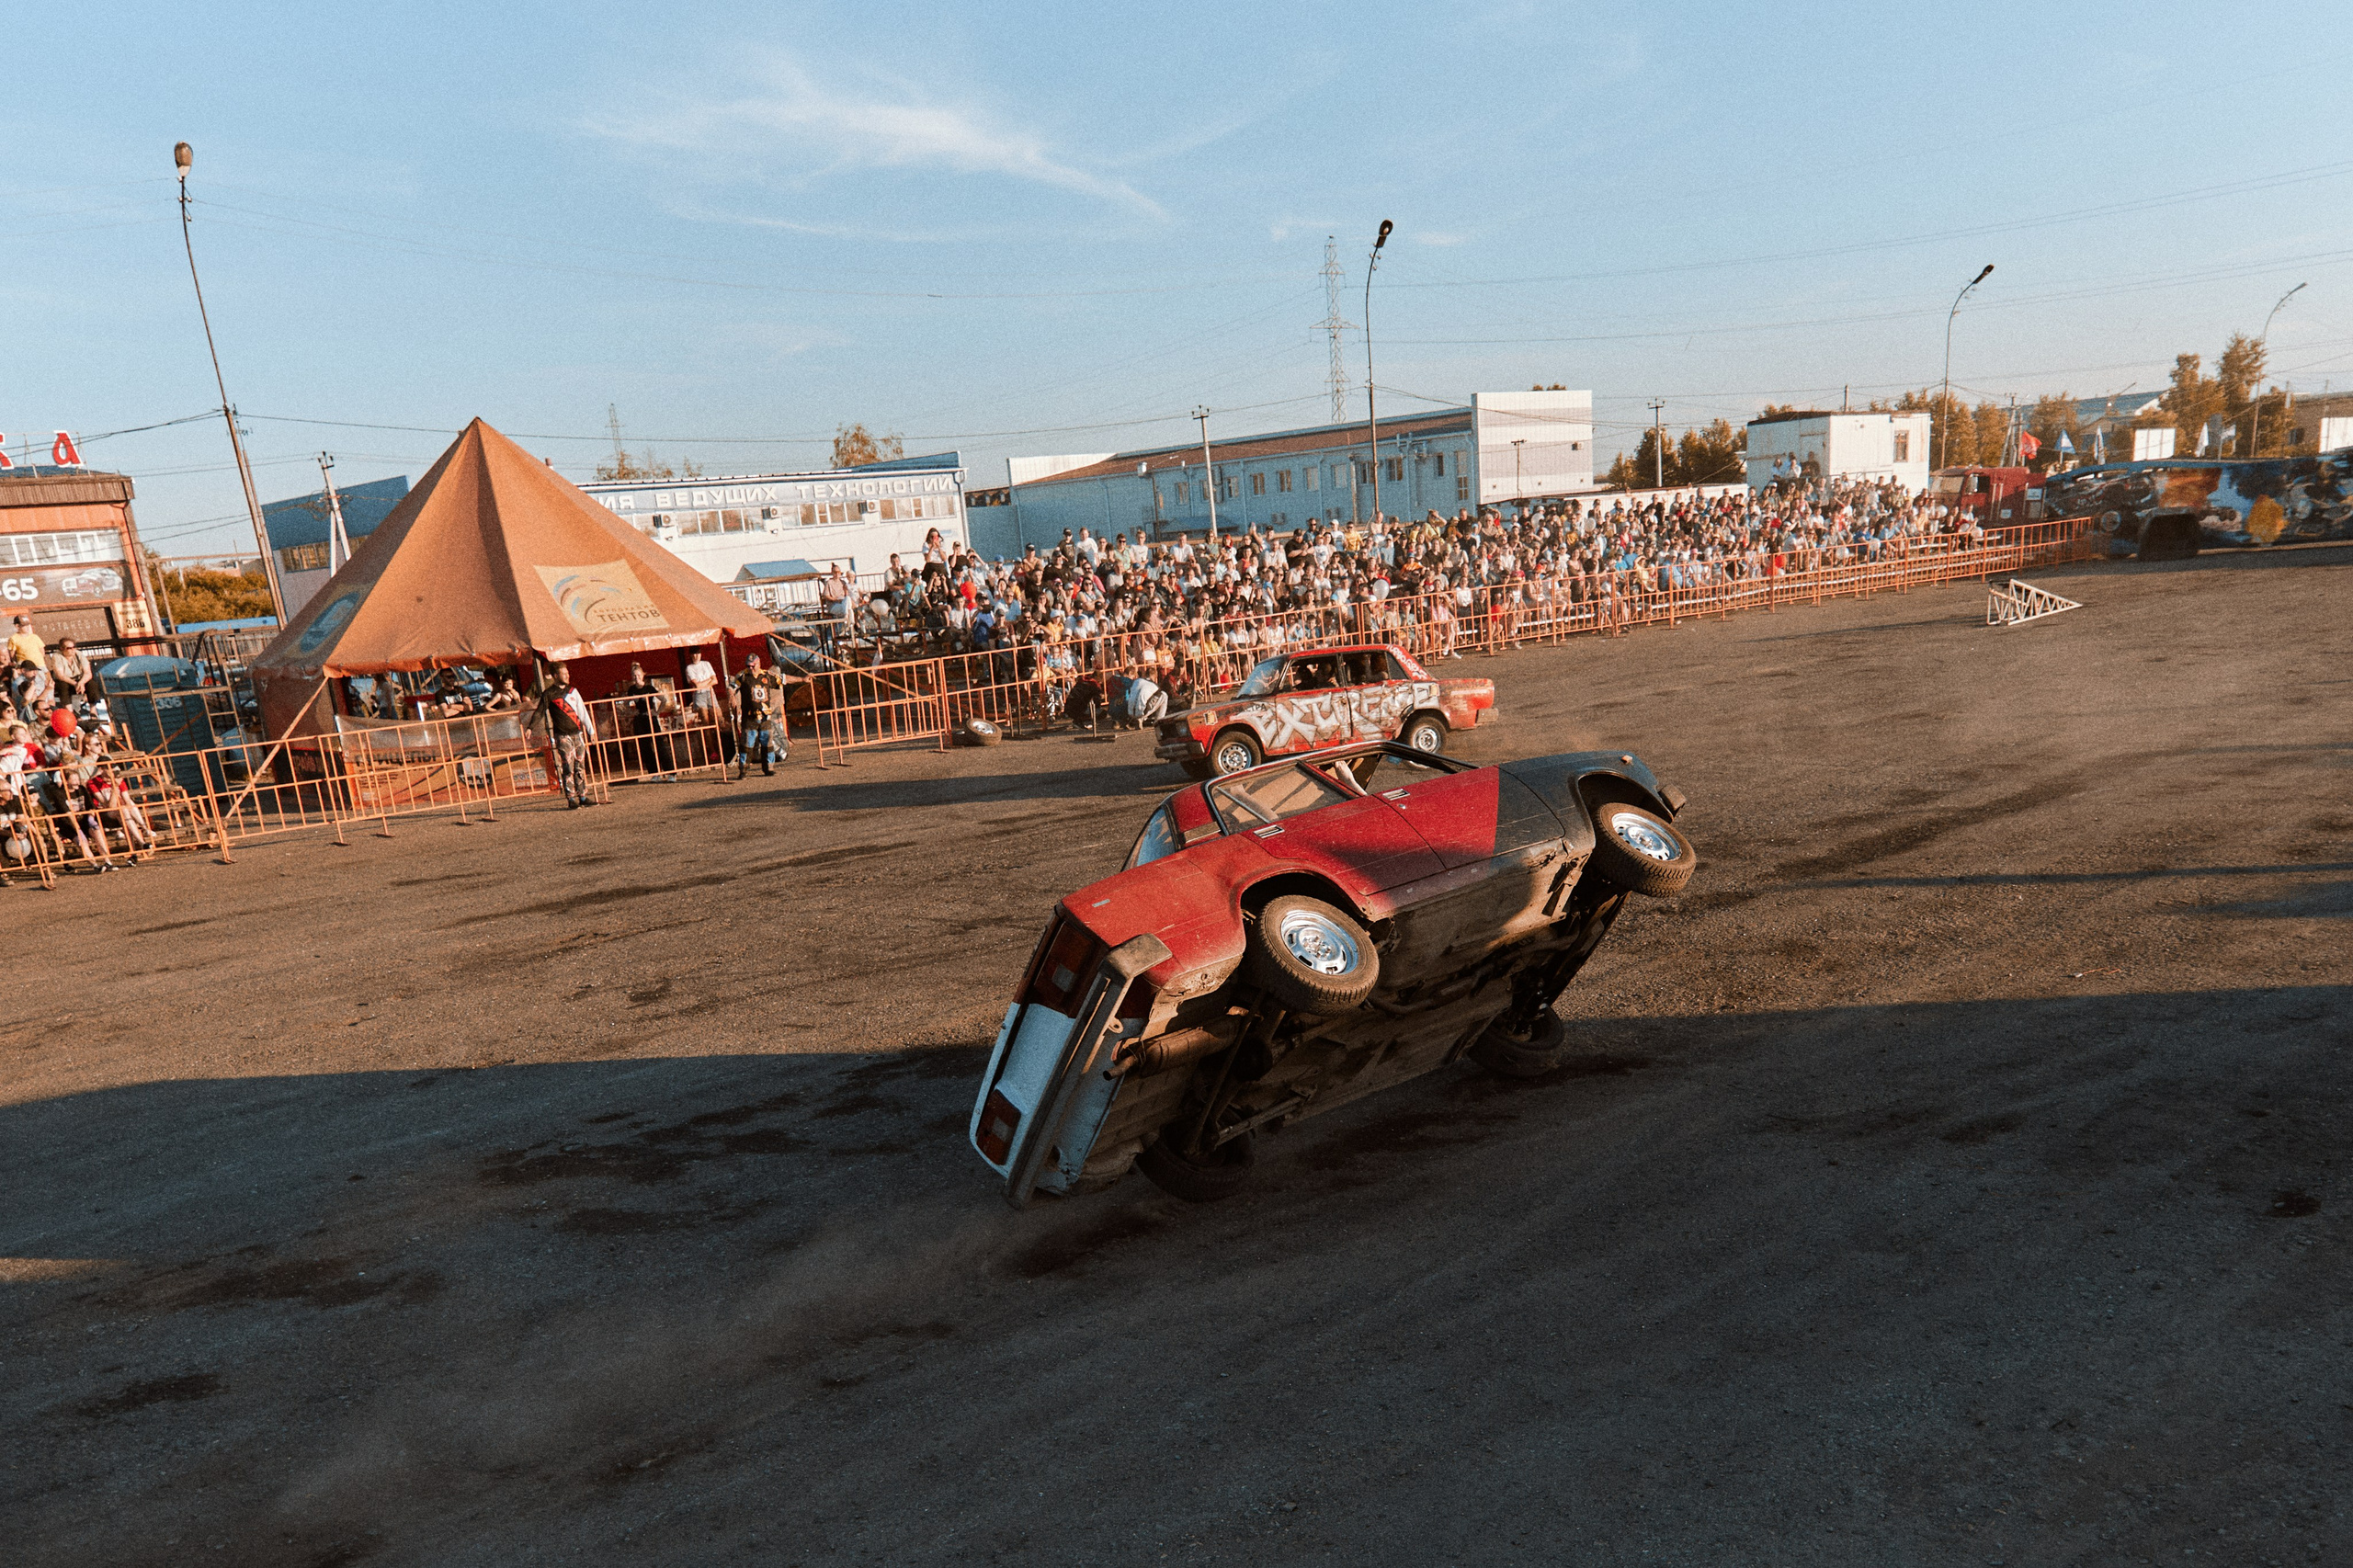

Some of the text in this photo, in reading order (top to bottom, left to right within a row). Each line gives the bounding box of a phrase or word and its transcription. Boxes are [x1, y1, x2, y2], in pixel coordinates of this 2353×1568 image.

[655, 486, 779, 507] ВЕДУЩИХ
[0, 578, 39, 601] 65
[597, 608, 661, 623] ТЕНТОВ
